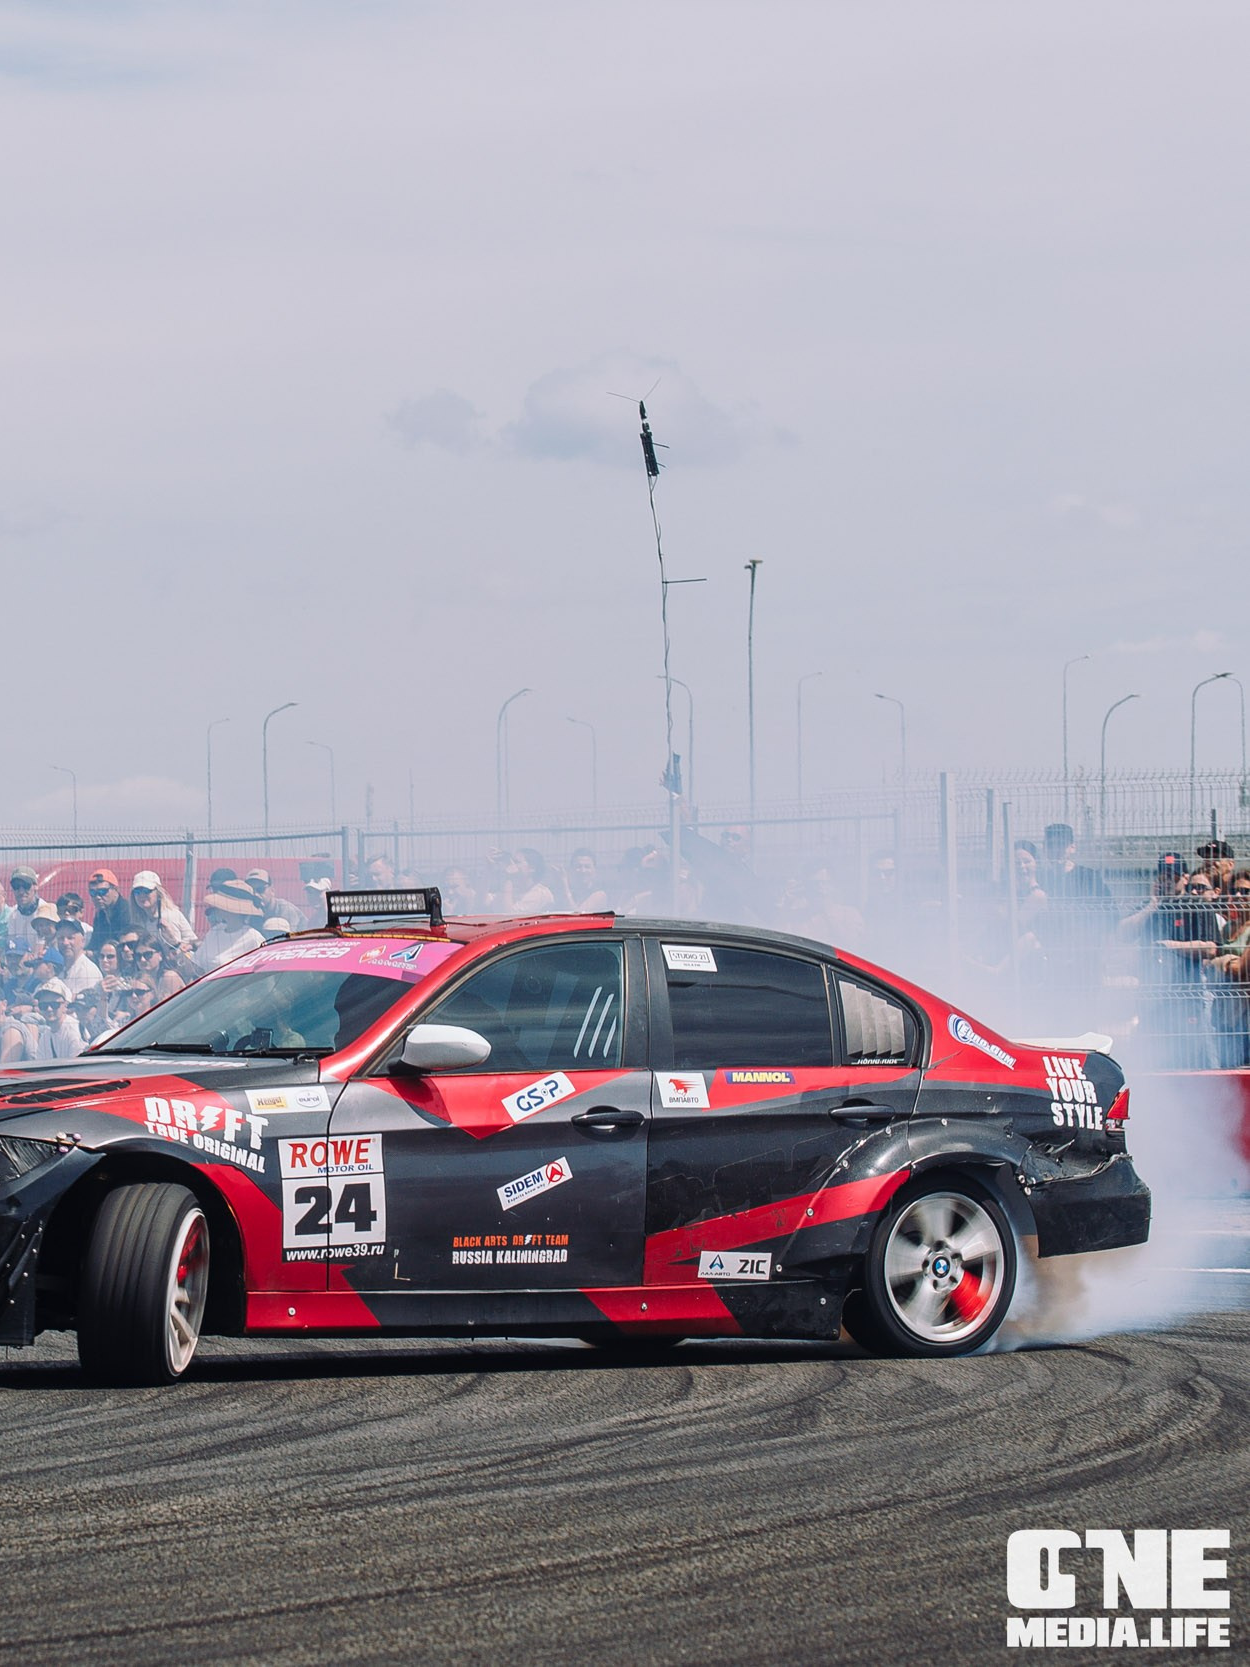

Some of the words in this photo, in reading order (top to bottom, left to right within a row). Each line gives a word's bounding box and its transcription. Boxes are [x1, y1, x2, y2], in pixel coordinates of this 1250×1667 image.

[732, 1072, 790, 1083] MANNOL
[1042, 1056, 1087, 1080] LIVE
[669, 1096, 699, 1104] ВМПАВТО
[1045, 1078, 1098, 1104] YOUR
[1051, 1102, 1103, 1131] STYLE
[144, 1121, 189, 1144] TRUE
[193, 1134, 266, 1174] ORIGINAL
[288, 1138, 372, 1168] ROWE
[317, 1164, 355, 1175] MOTOR
[357, 1163, 374, 1172] OIL
[504, 1171, 544, 1198] SIDEM
[294, 1182, 377, 1236] 24
[453, 1236, 482, 1248] BLACK
[484, 1235, 508, 1247] ARTS
[545, 1234, 569, 1246] TEAM
[286, 1243, 385, 1262] www.rowe39.ru
[452, 1250, 493, 1265] RUSSIA
[496, 1248, 568, 1264] KALININGRAD
[737, 1259, 767, 1275] ZIC
